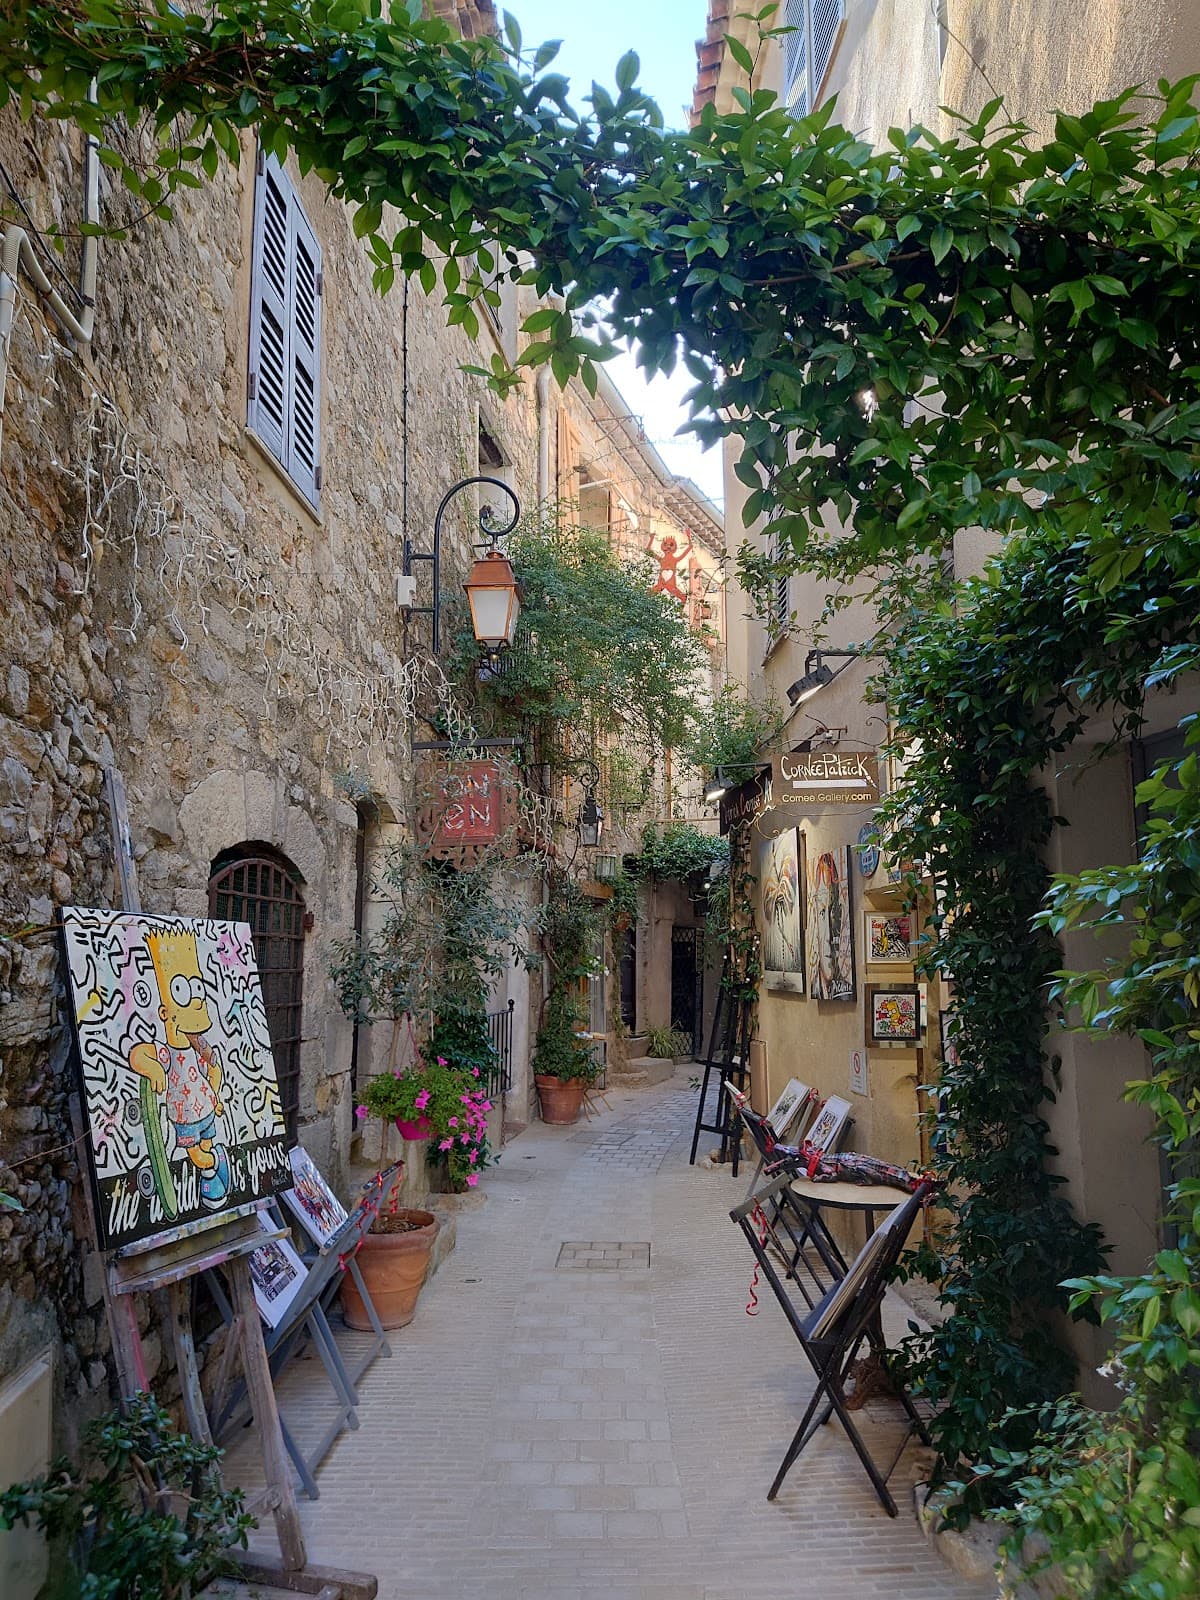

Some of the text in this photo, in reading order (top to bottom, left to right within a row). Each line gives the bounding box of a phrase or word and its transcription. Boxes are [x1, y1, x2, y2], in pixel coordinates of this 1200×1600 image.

[109, 1142, 291, 1235] the wrld is yours
